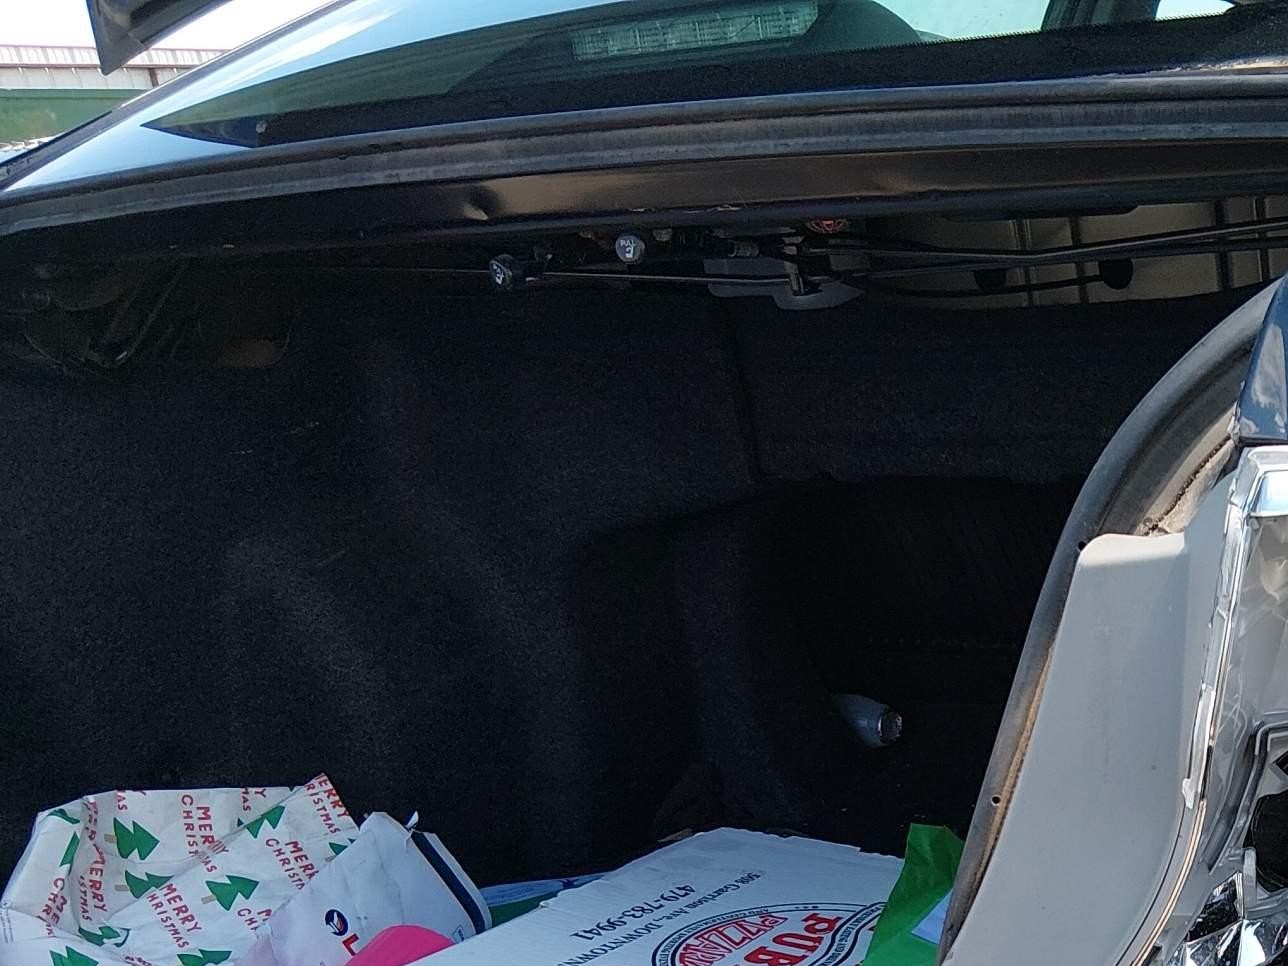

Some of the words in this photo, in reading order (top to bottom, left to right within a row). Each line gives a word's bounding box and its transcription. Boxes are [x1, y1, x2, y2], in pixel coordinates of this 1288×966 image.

[146, 893, 189, 949] HRISTMAS
[159, 883, 202, 932] MERRY
[570, 884, 697, 941] 479-783-9941
